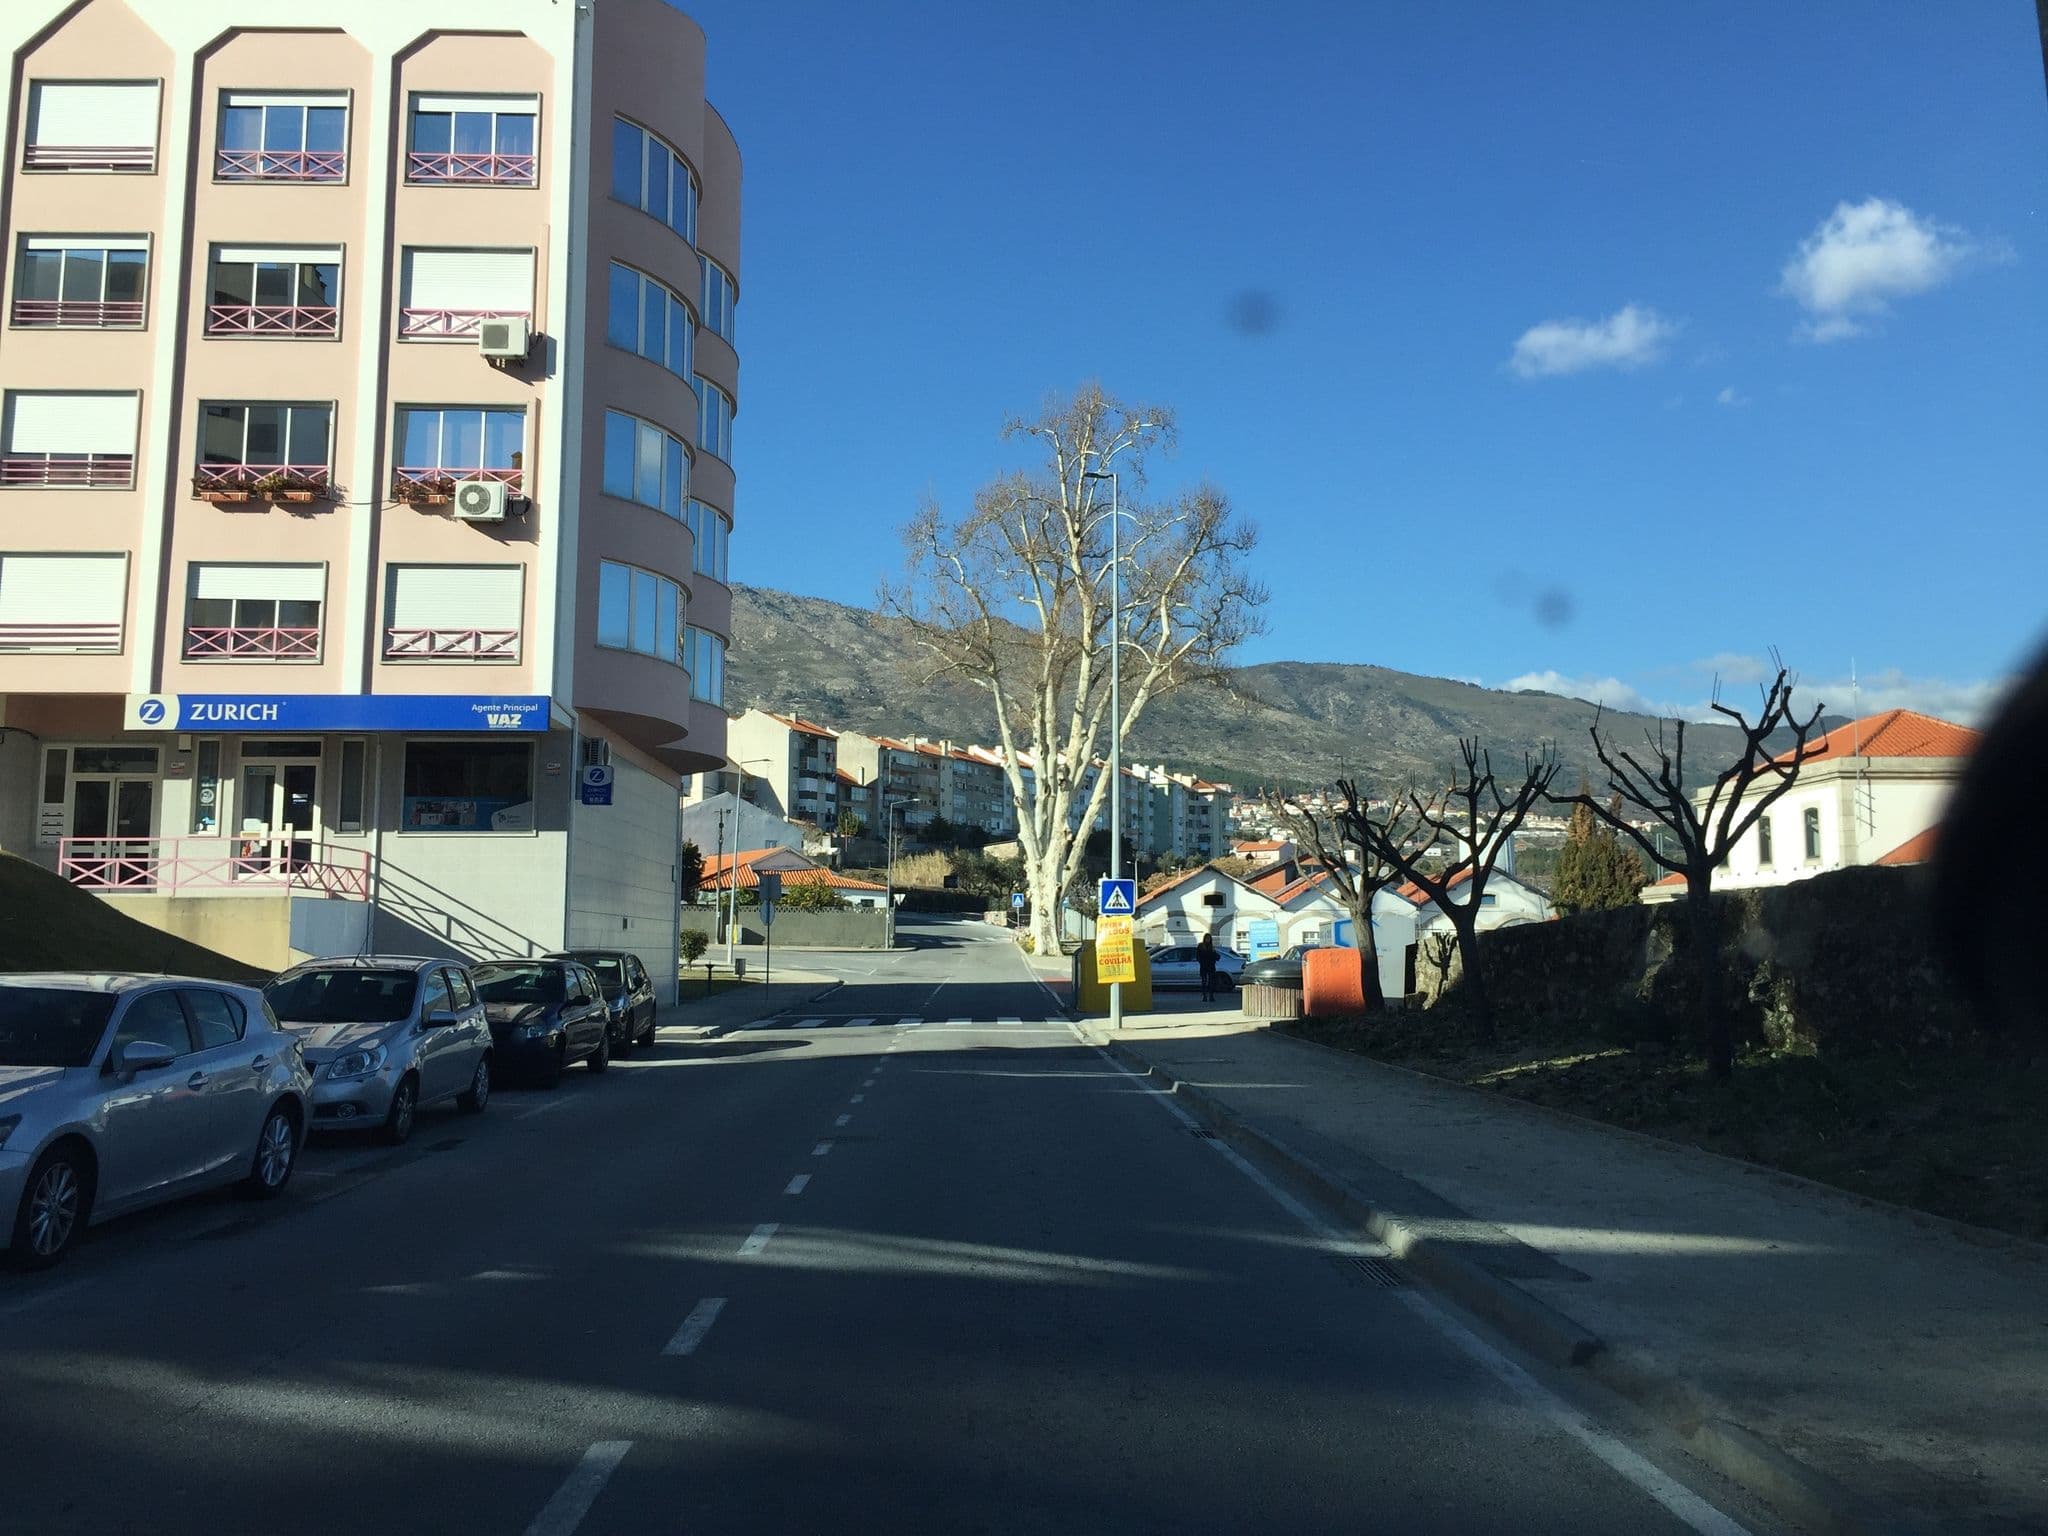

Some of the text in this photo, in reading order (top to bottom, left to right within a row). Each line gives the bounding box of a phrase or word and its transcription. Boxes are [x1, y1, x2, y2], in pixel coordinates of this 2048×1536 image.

[190, 704, 278, 721] ZURICH
[471, 703, 538, 713] Agente Principal
[487, 714, 522, 725] VAZ
